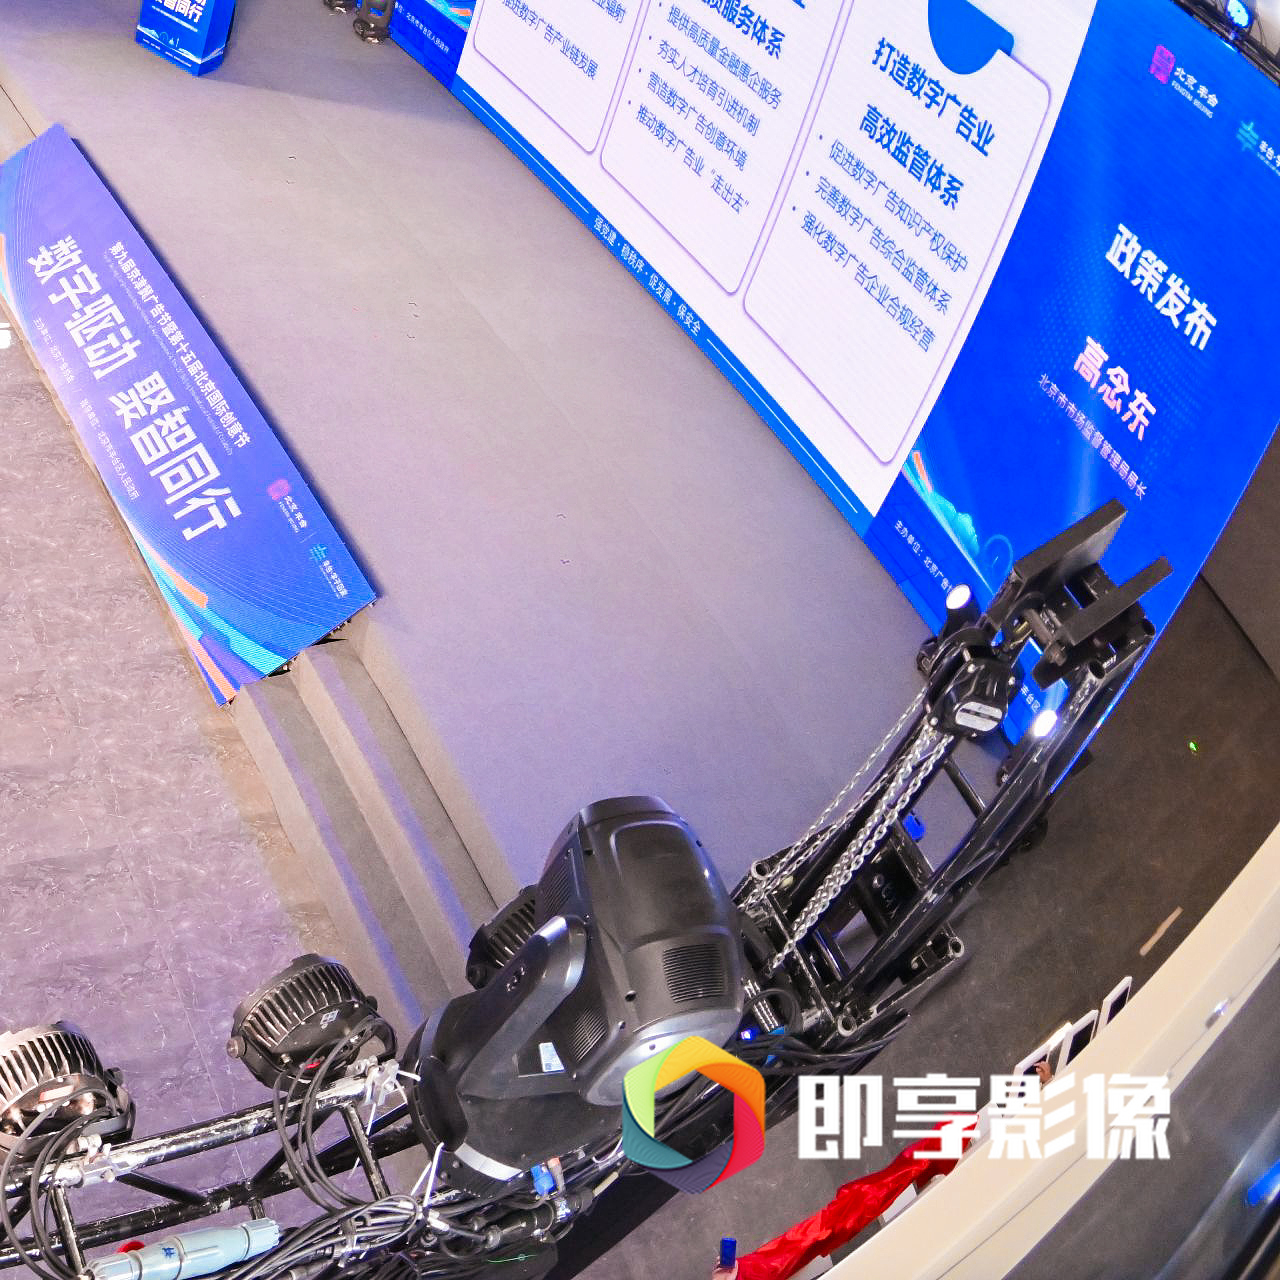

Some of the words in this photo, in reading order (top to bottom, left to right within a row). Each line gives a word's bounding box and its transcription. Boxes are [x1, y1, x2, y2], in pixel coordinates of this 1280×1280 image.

[656, 38, 761, 137] 夯实人才培育引进机制
[666, 4, 783, 110] 提供高质量金融惠企服务
[871, 37, 996, 158] 打造数字广告业
[646, 71, 749, 173] 营造数字广告创意环境
[859, 103, 965, 210] 高效监管体系
[814, 175, 953, 317] 完善数字广告综合监管体系
[828, 138, 970, 274] 促进数字广告知识产权保护
[109, 240, 252, 449] 第九届京津冀广告节暨第十五届北京国际创意节
[800, 209, 937, 353] 强化数字广告企业合规经营
[1105, 222, 1218, 352] 政策发布
[26, 234, 142, 381] 数字驱动
[107, 369, 242, 542] 聚智同行
[1037, 373, 1148, 502] 北京市市场监督管理局局长
[1073, 334, 1158, 442] 高念东
